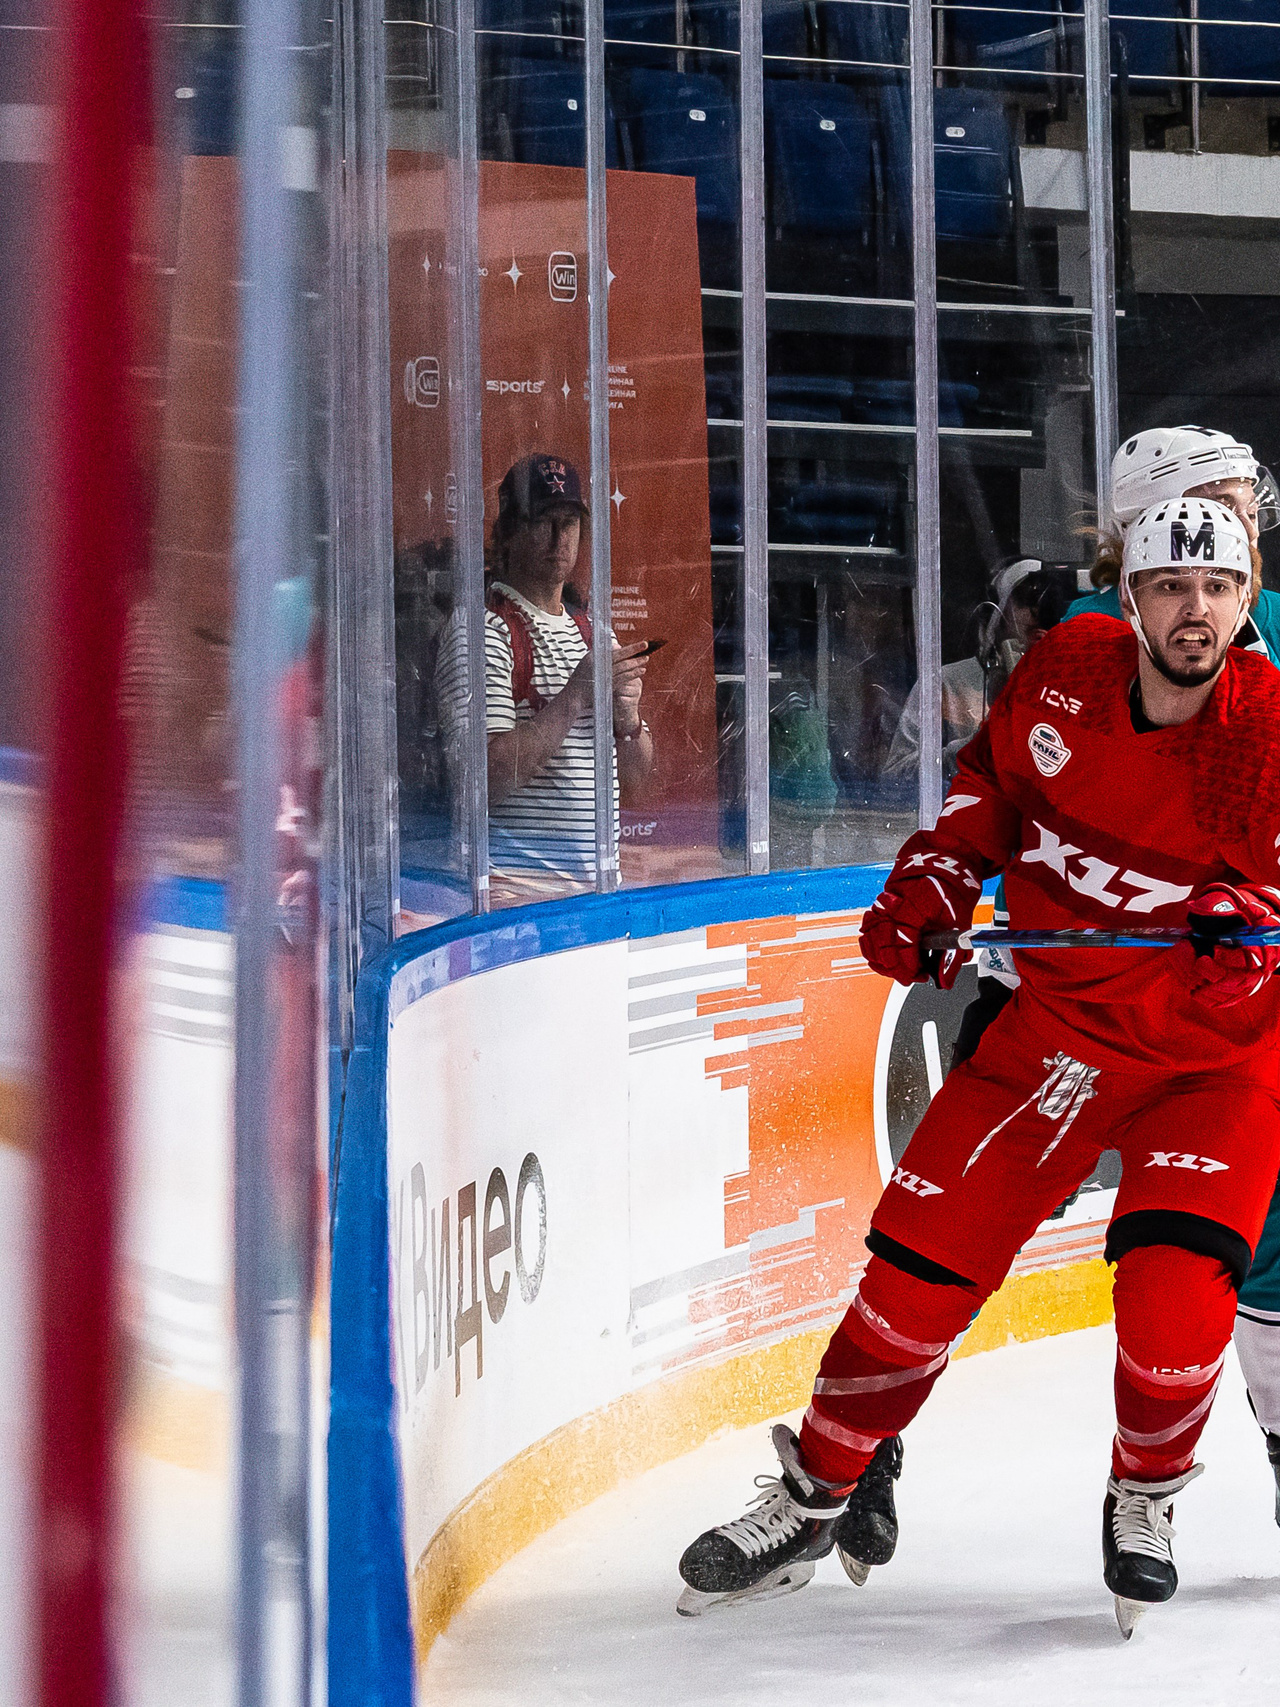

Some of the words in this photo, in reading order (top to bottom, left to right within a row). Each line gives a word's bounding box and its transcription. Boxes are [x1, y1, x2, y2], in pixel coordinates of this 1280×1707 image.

[902, 852, 981, 890] X17
[1020, 819, 1195, 914] X17
[1143, 1151, 1230, 1174] X17
[891, 1166, 945, 1198] X17
[410, 1151, 548, 1399] Видео
